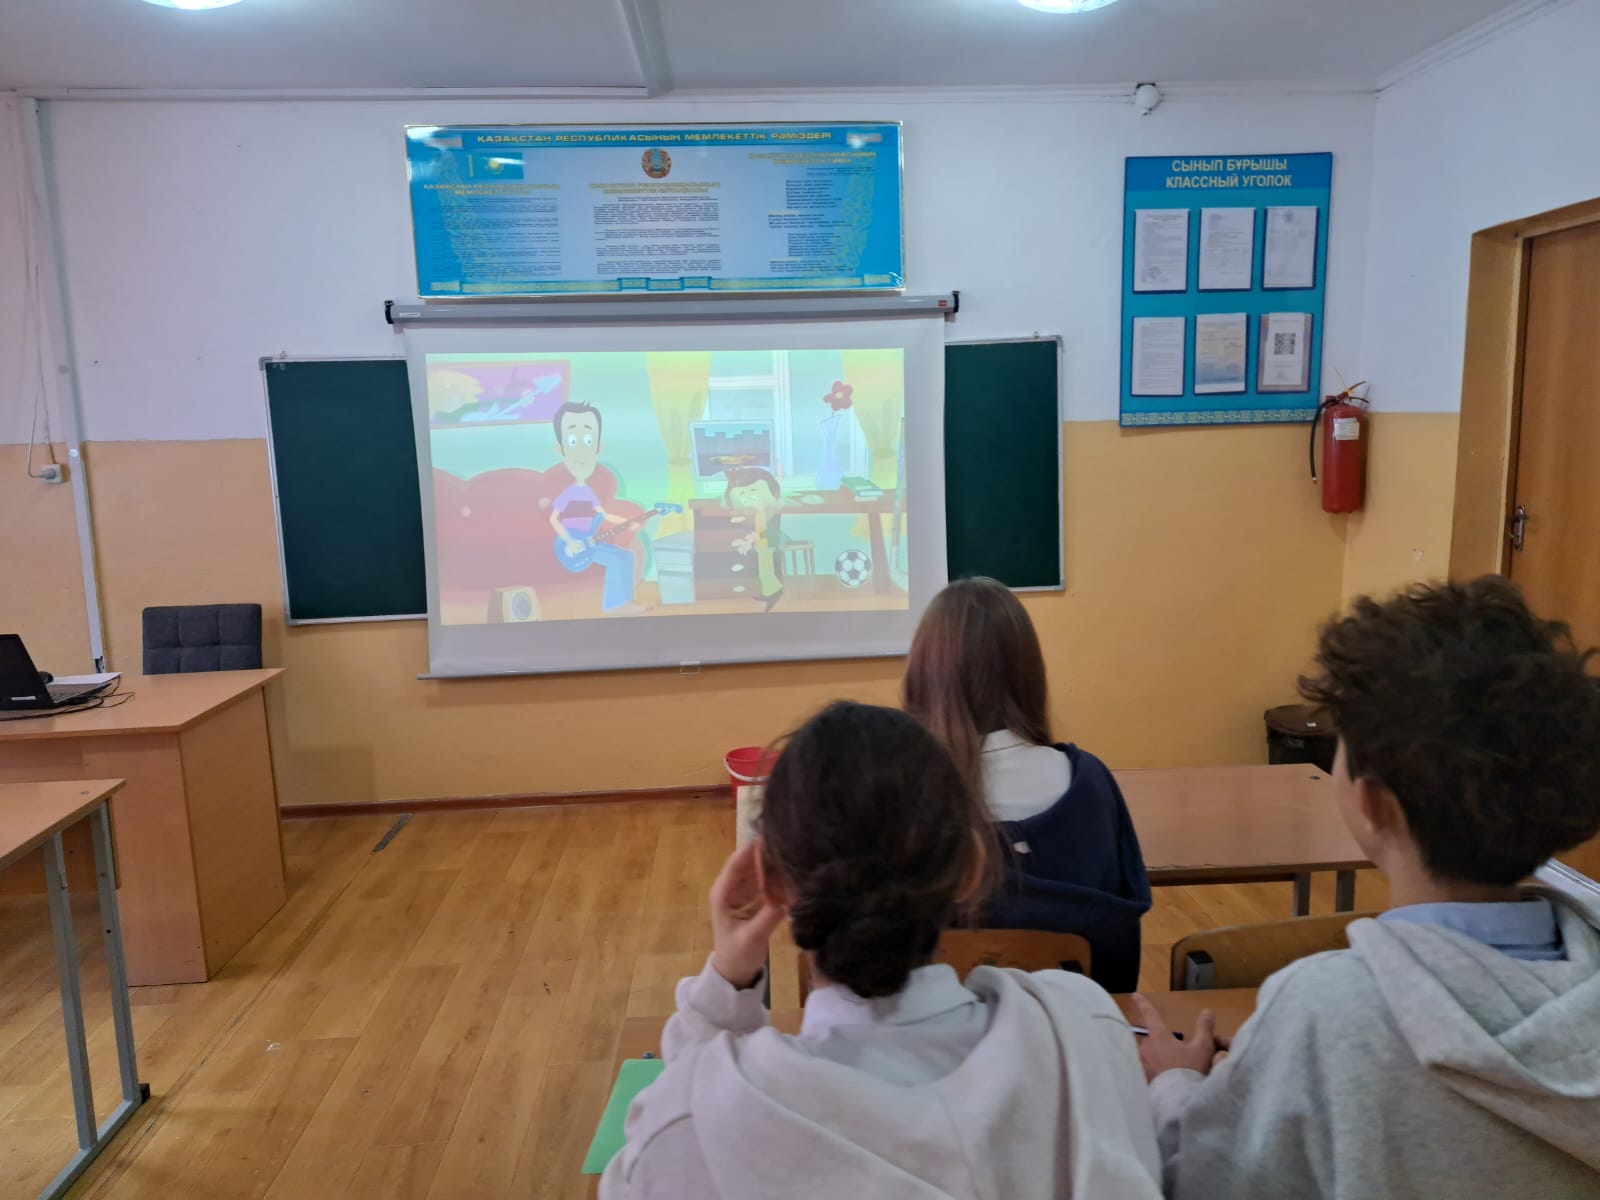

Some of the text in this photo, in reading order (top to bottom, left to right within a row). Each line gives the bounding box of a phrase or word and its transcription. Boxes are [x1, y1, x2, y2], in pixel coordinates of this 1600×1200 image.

[1172, 158, 1287, 172] СЫНЫП БҰРЫШЫ
[1166, 174, 1292, 188] КЛАССНЫЙ УГОЛОК
